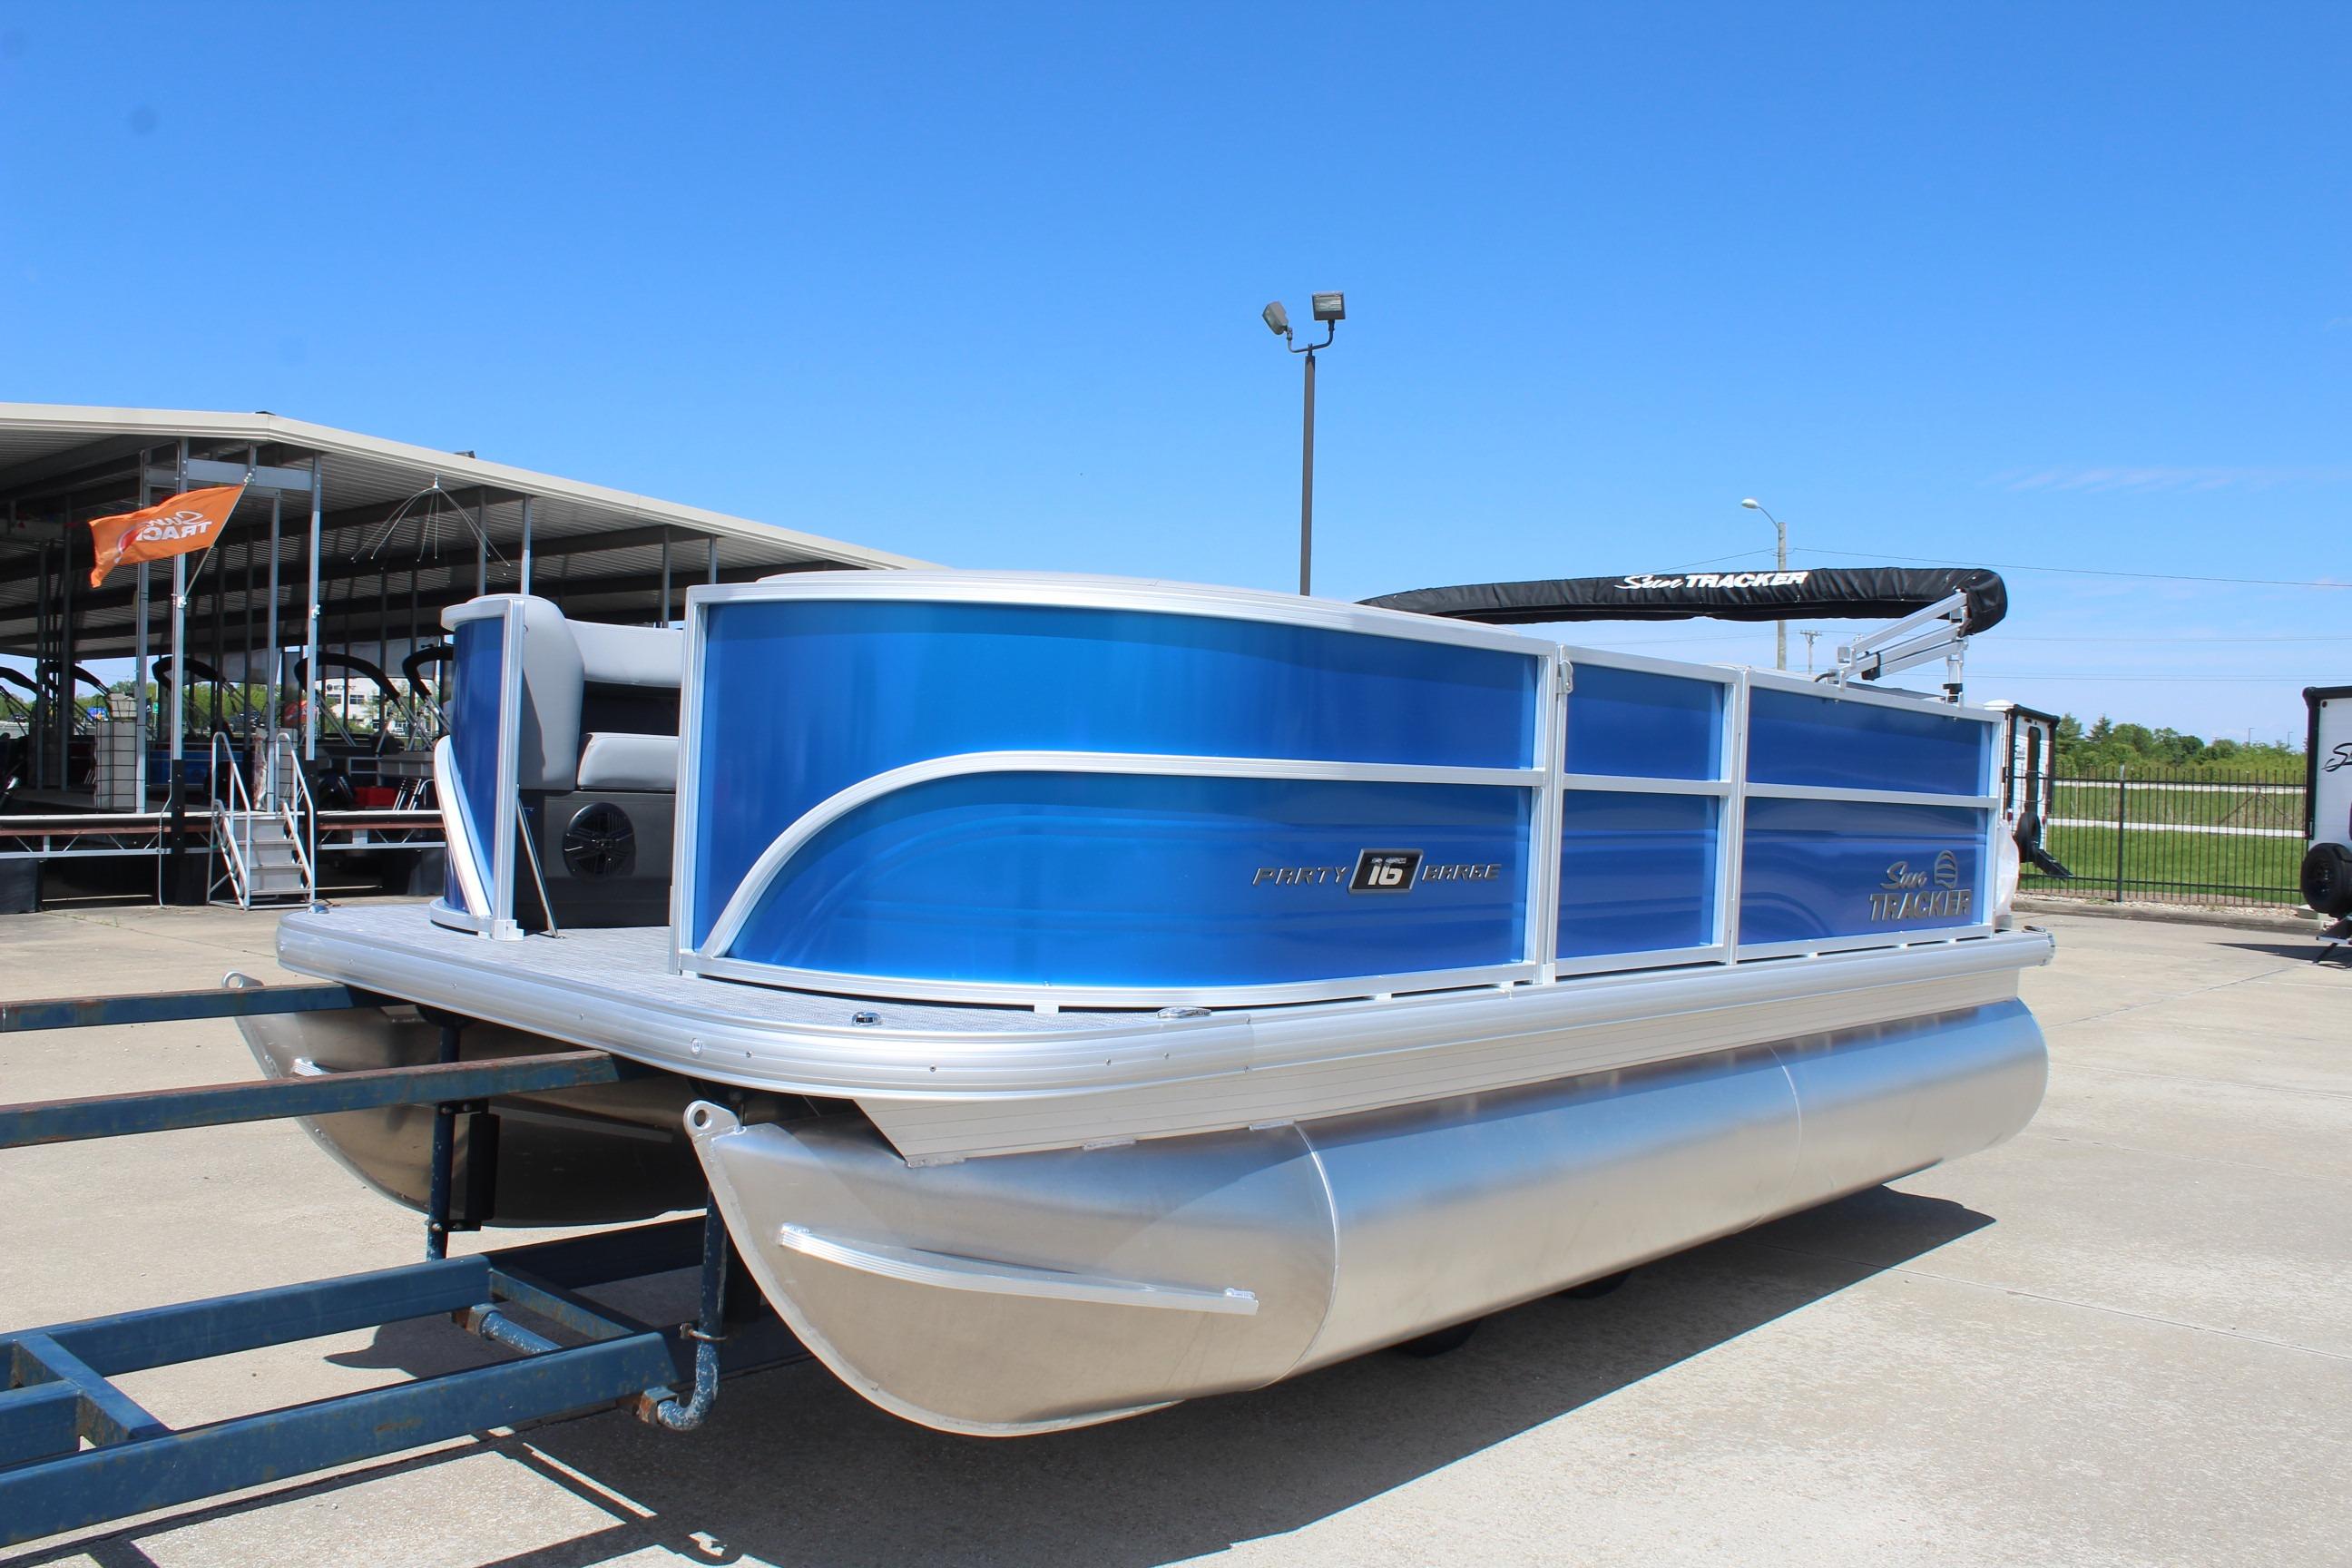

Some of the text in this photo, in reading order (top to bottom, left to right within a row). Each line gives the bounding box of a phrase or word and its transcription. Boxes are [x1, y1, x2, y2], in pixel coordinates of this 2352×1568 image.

[1614, 572, 1808, 590] Sun TRACKER
[1251, 857, 1503, 886] PARTY 16 BARGE
[1880, 860, 1927, 890] Sun
[1869, 889, 1972, 922] TRACKER
